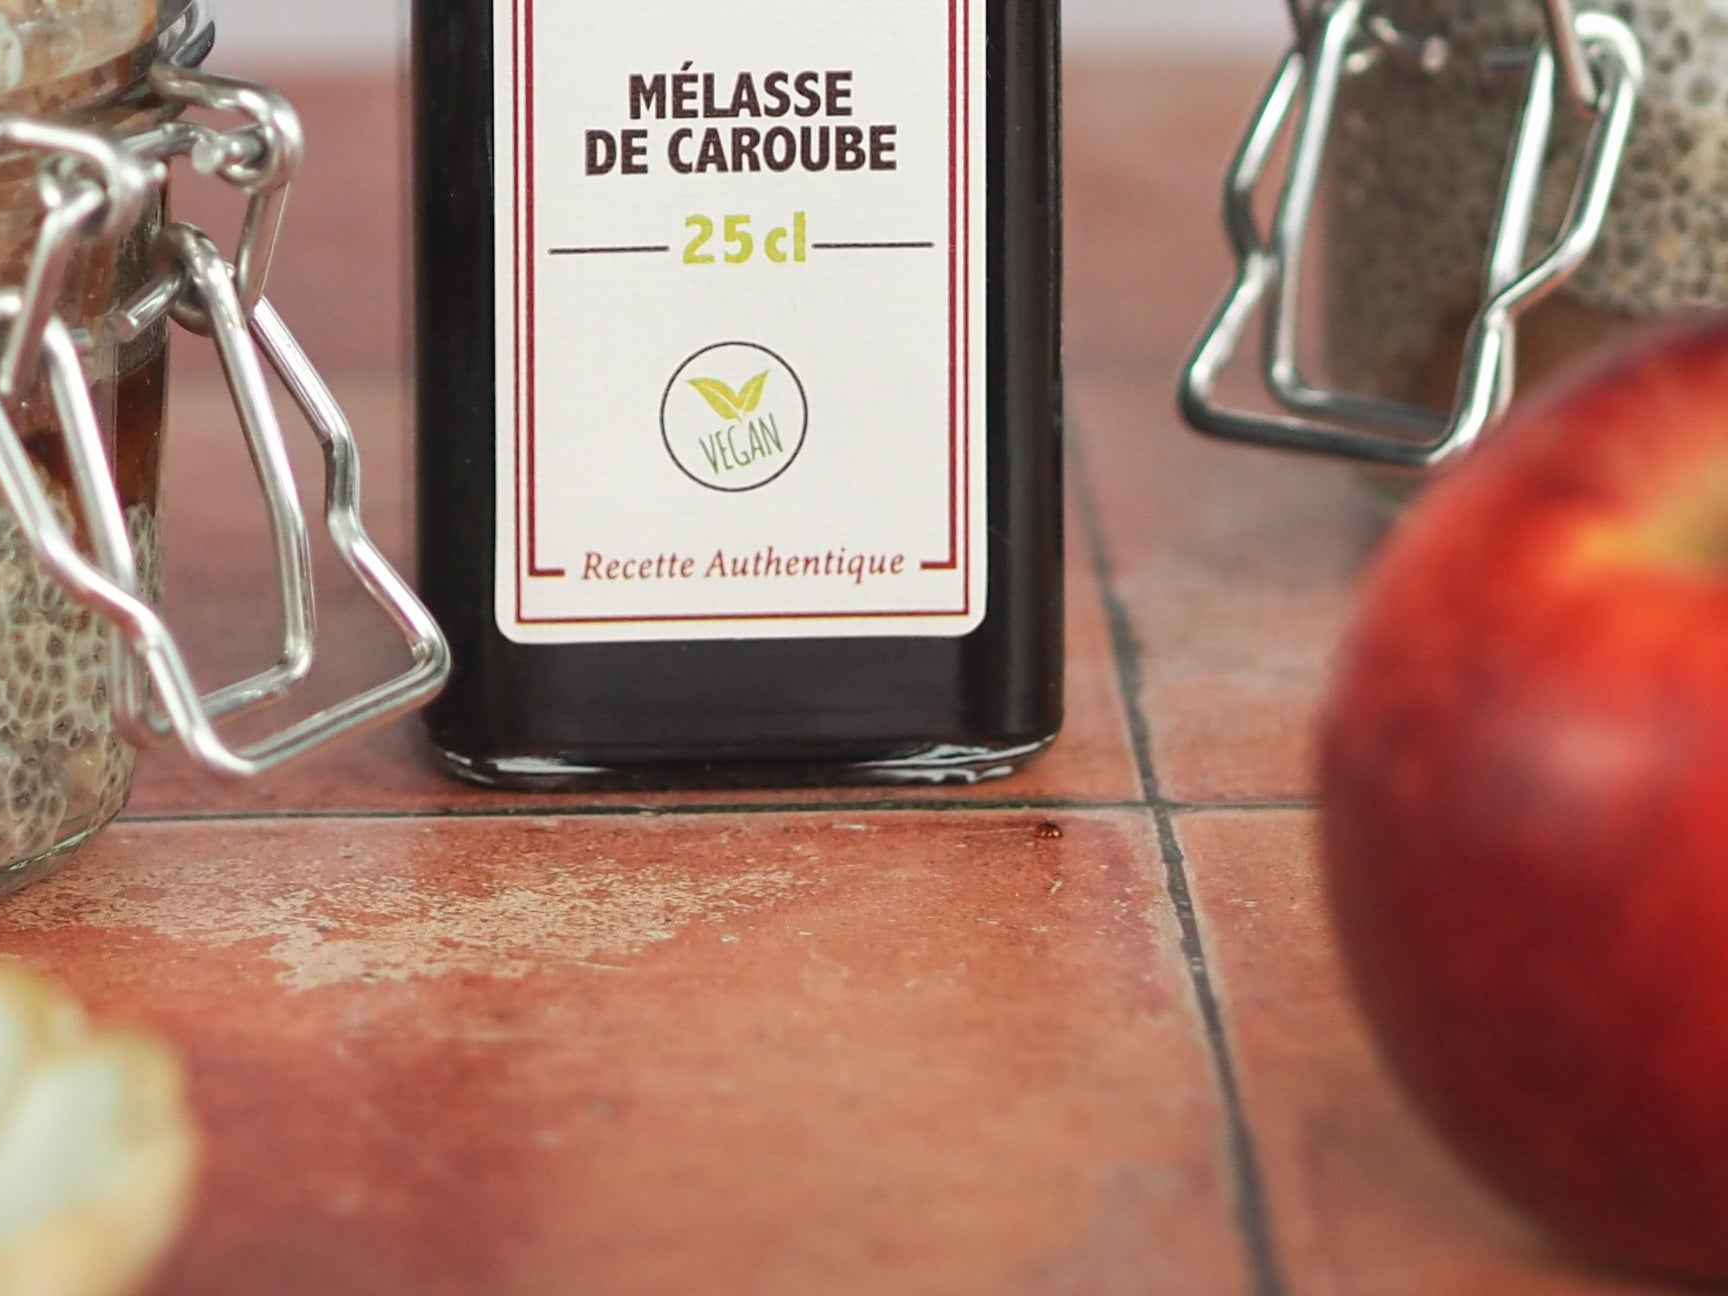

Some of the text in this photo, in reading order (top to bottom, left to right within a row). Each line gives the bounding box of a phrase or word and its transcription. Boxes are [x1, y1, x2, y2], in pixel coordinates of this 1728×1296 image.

[628, 60, 853, 119] MÉLASSE
[584, 124, 897, 177] DE CAROUBE
[697, 412, 783, 475] VEGAN
[582, 546, 905, 585] Recette Authentique
